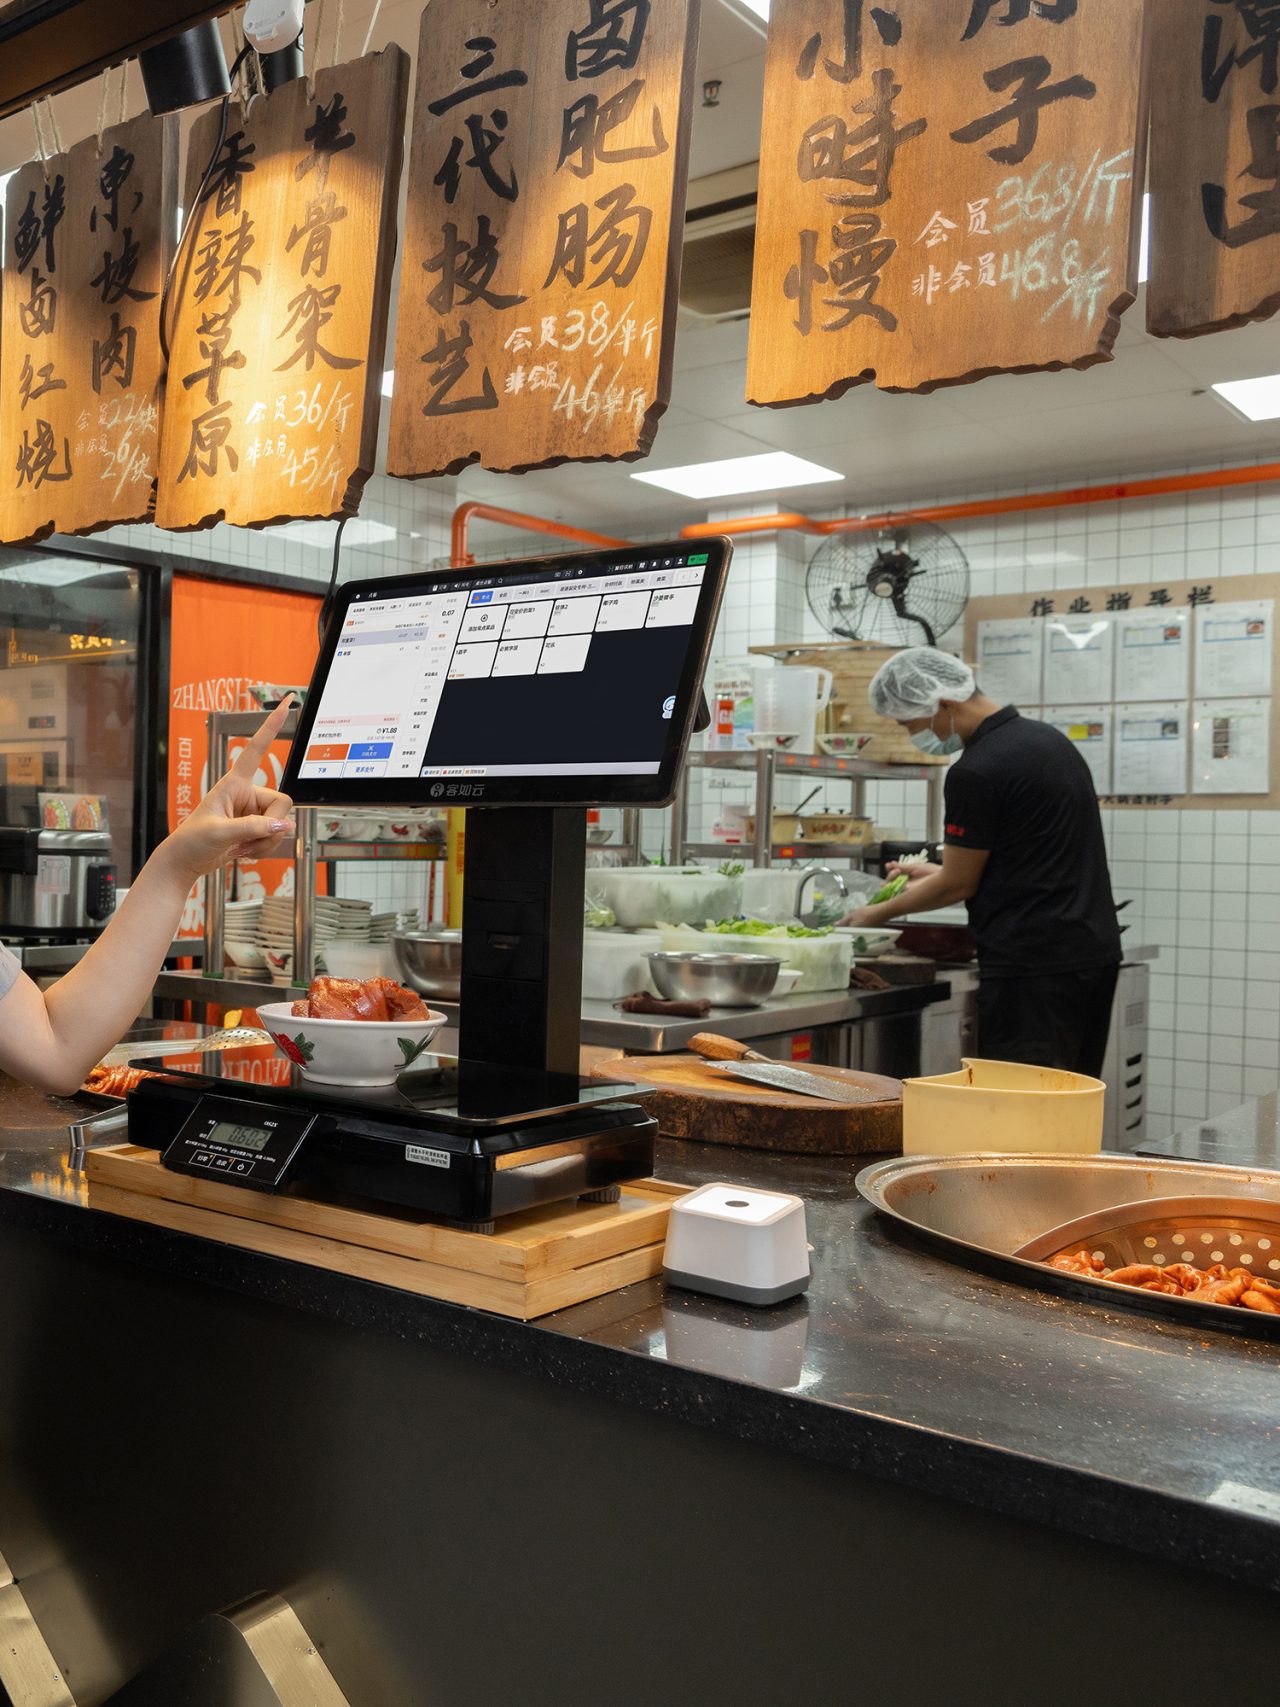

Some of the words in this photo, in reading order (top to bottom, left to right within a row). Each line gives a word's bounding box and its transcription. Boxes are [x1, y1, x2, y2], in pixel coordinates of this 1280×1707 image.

[177, 132, 262, 485] 香辣草原
[273, 94, 365, 372] 羊骨架
[421, 36, 529, 417] 三代技艺
[1030, 585, 1215, 617] 作业指导栏
[446, 784, 485, 796] 客如云
